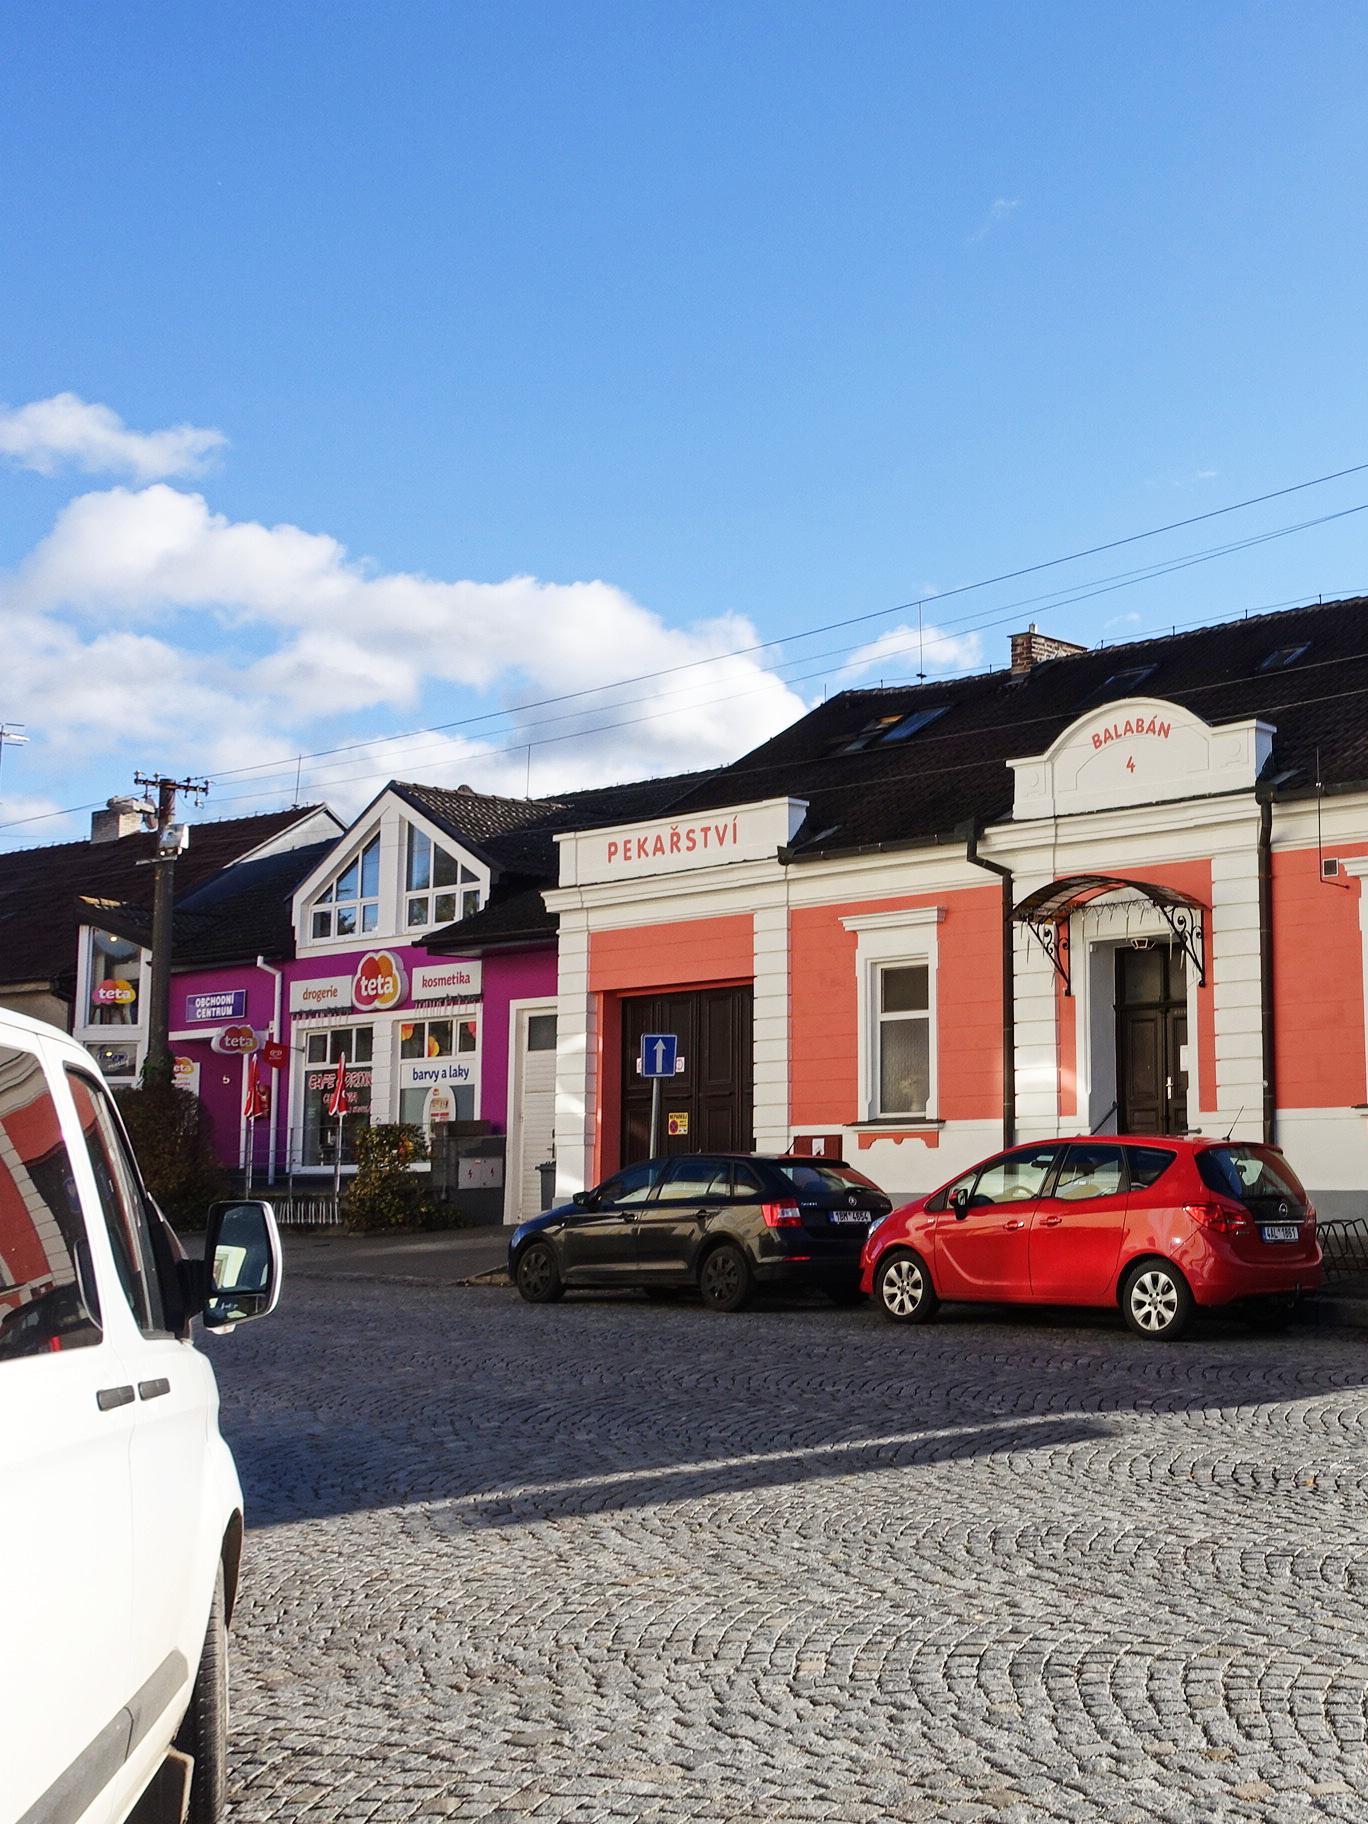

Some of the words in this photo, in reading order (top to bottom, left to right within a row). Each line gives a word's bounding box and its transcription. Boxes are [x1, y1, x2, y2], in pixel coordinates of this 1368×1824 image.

[1091, 714, 1171, 750] BALABÁN
[1126, 755, 1135, 773] 4
[607, 814, 738, 864] PEKAŘSTVÍ
[360, 974, 394, 996] teta
[421, 971, 471, 988] kosmetika
[98, 987, 131, 999] teta
[302, 984, 338, 1003] drogerie
[196, 1006, 233, 1019] CENTRUM
[224, 1036, 253, 1047] teta
[173, 1063, 191, 1072] eta
[412, 1067, 440, 1083] barvy
[441, 1069, 447, 1079] a
[449, 1064, 470, 1080] laky
[222, 1075, 230, 1085] 5
